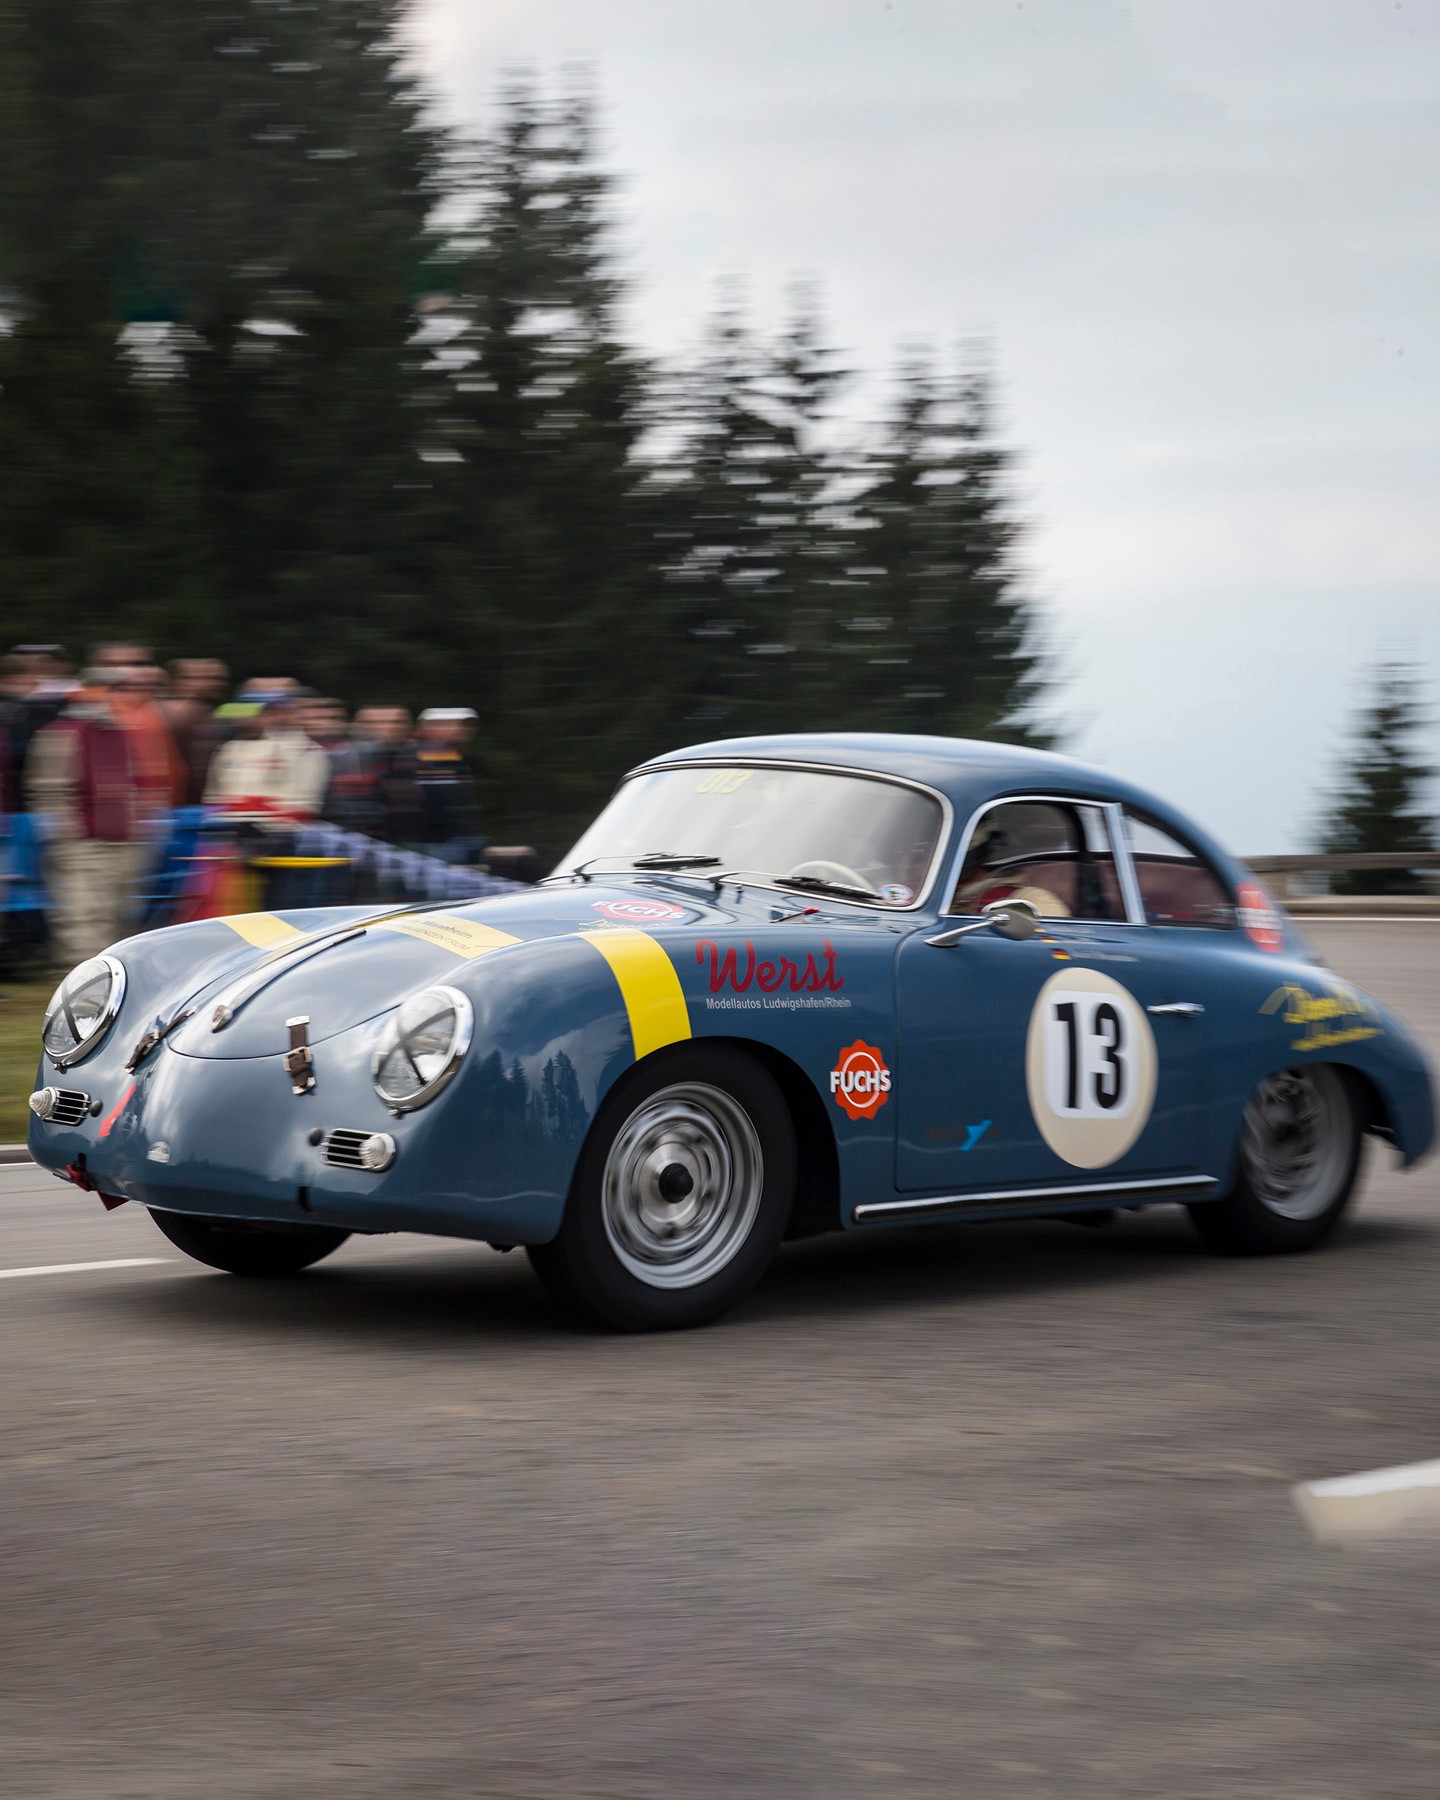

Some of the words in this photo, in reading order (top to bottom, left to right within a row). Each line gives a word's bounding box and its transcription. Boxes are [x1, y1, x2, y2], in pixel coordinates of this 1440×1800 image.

[590, 900, 688, 920] FUCHS
[420, 920, 474, 939] Mannheim
[695, 938, 845, 993] Werst
[706, 997, 761, 1010] Modellautos
[763, 996, 852, 1011] Ludwigshafen/Rhein
[1053, 1001, 1124, 1111] 13
[829, 1069, 893, 1094] FUCHS
